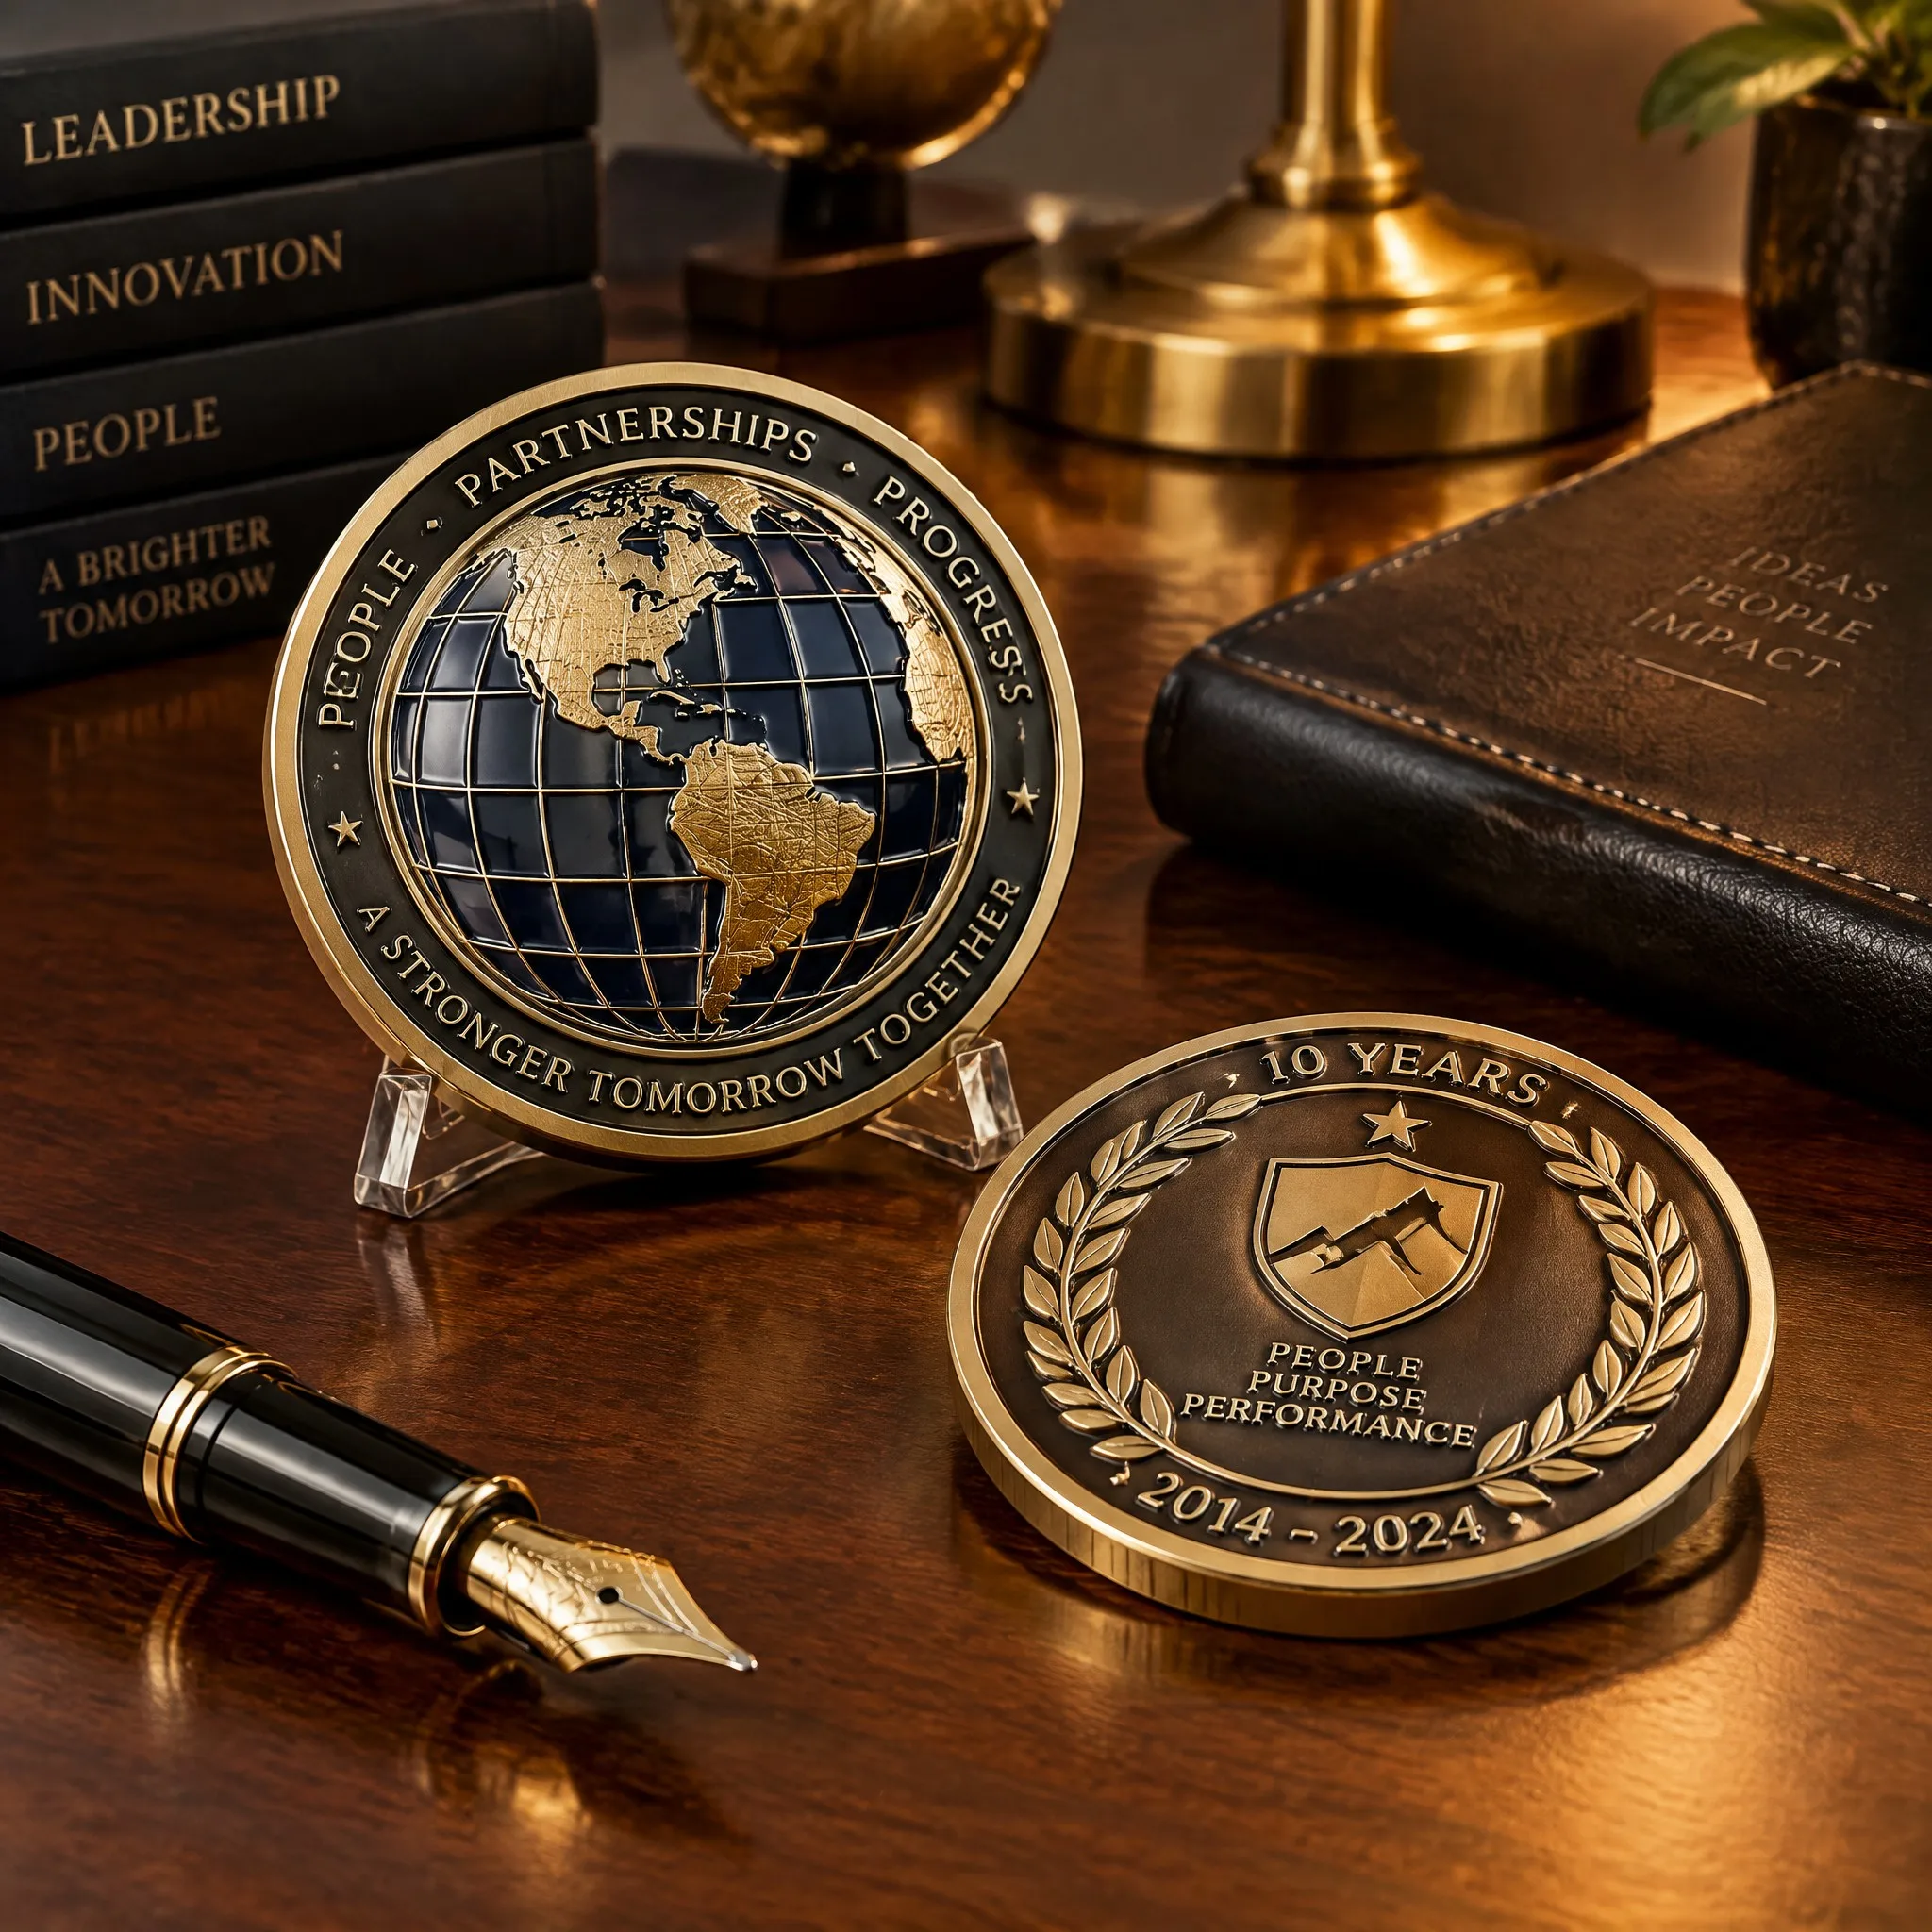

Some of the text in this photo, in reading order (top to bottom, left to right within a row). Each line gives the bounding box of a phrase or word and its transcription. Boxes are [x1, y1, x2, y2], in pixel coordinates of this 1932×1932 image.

[21, 74, 341, 166] LEADERSHIP
[26, 229, 344, 325] INNOVATION
[33, 396, 221, 471] PEOPLE
[39, 515, 272, 594] A BRIGHTER
[318, 405, 1034, 729] PEOPLE PARTNERSHIPS PROGRESS
[1730, 546, 1888, 603] IDEAS
[40, 563, 275, 643] TOMORROW
[1675, 576, 1873, 644] PEOPLE
[1629, 607, 1841, 678] IMPACT
[358, 877, 1021, 1115] A STRONGER TOMORROW TOGETHER
[1260, 1042, 1549, 1107] 10 YEARS
[1248, 1371, 1427, 1414] PURPOSE
[1267, 1341, 1424, 1381] PEOPLE
[1180, 1393, 1476, 1449] PERFORMANCE
[1137, 1472, 1274, 1544] 2014
[1332, 1504, 1486, 1557] 2024
